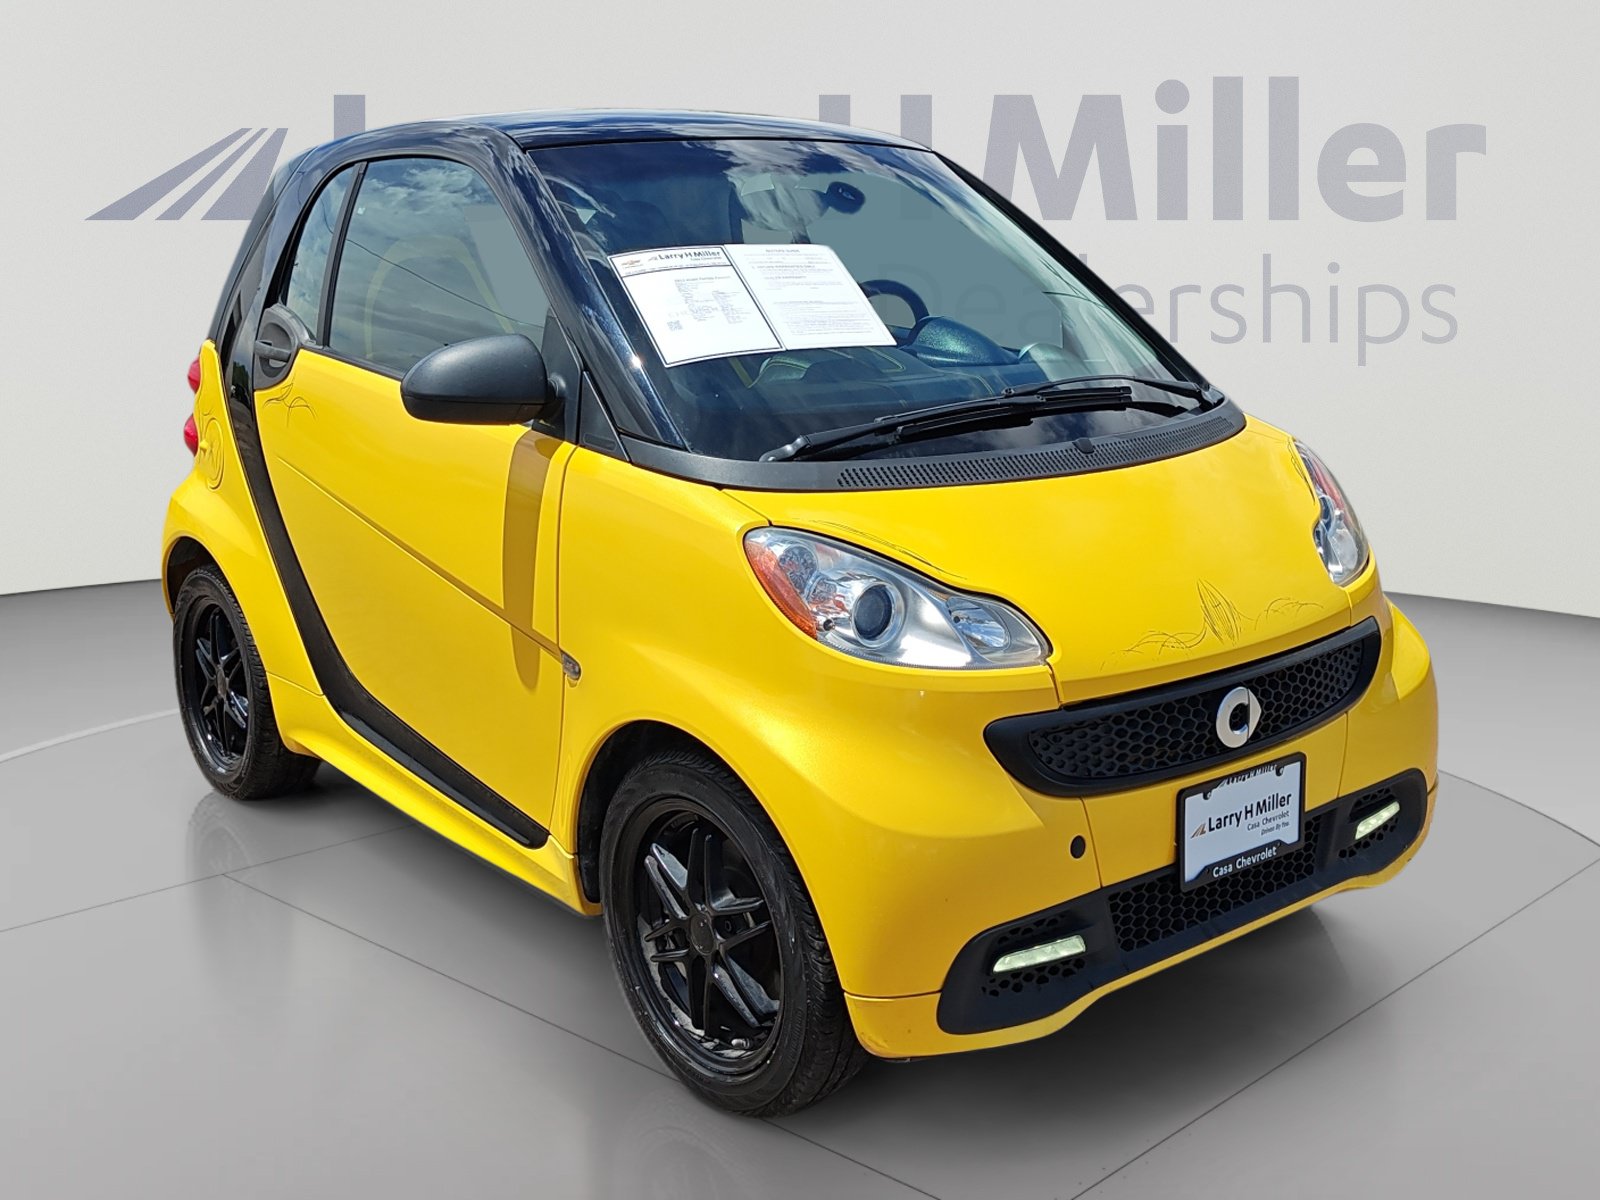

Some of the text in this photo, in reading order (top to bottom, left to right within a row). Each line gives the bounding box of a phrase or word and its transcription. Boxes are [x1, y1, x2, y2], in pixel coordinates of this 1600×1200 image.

[979, 76, 1487, 222] Miller
[1208, 793, 1292, 832] Larry H Miller
[1247, 810, 1290, 831] Casa Chevrolet
[1212, 846, 1277, 877] Casa Chevrolet
